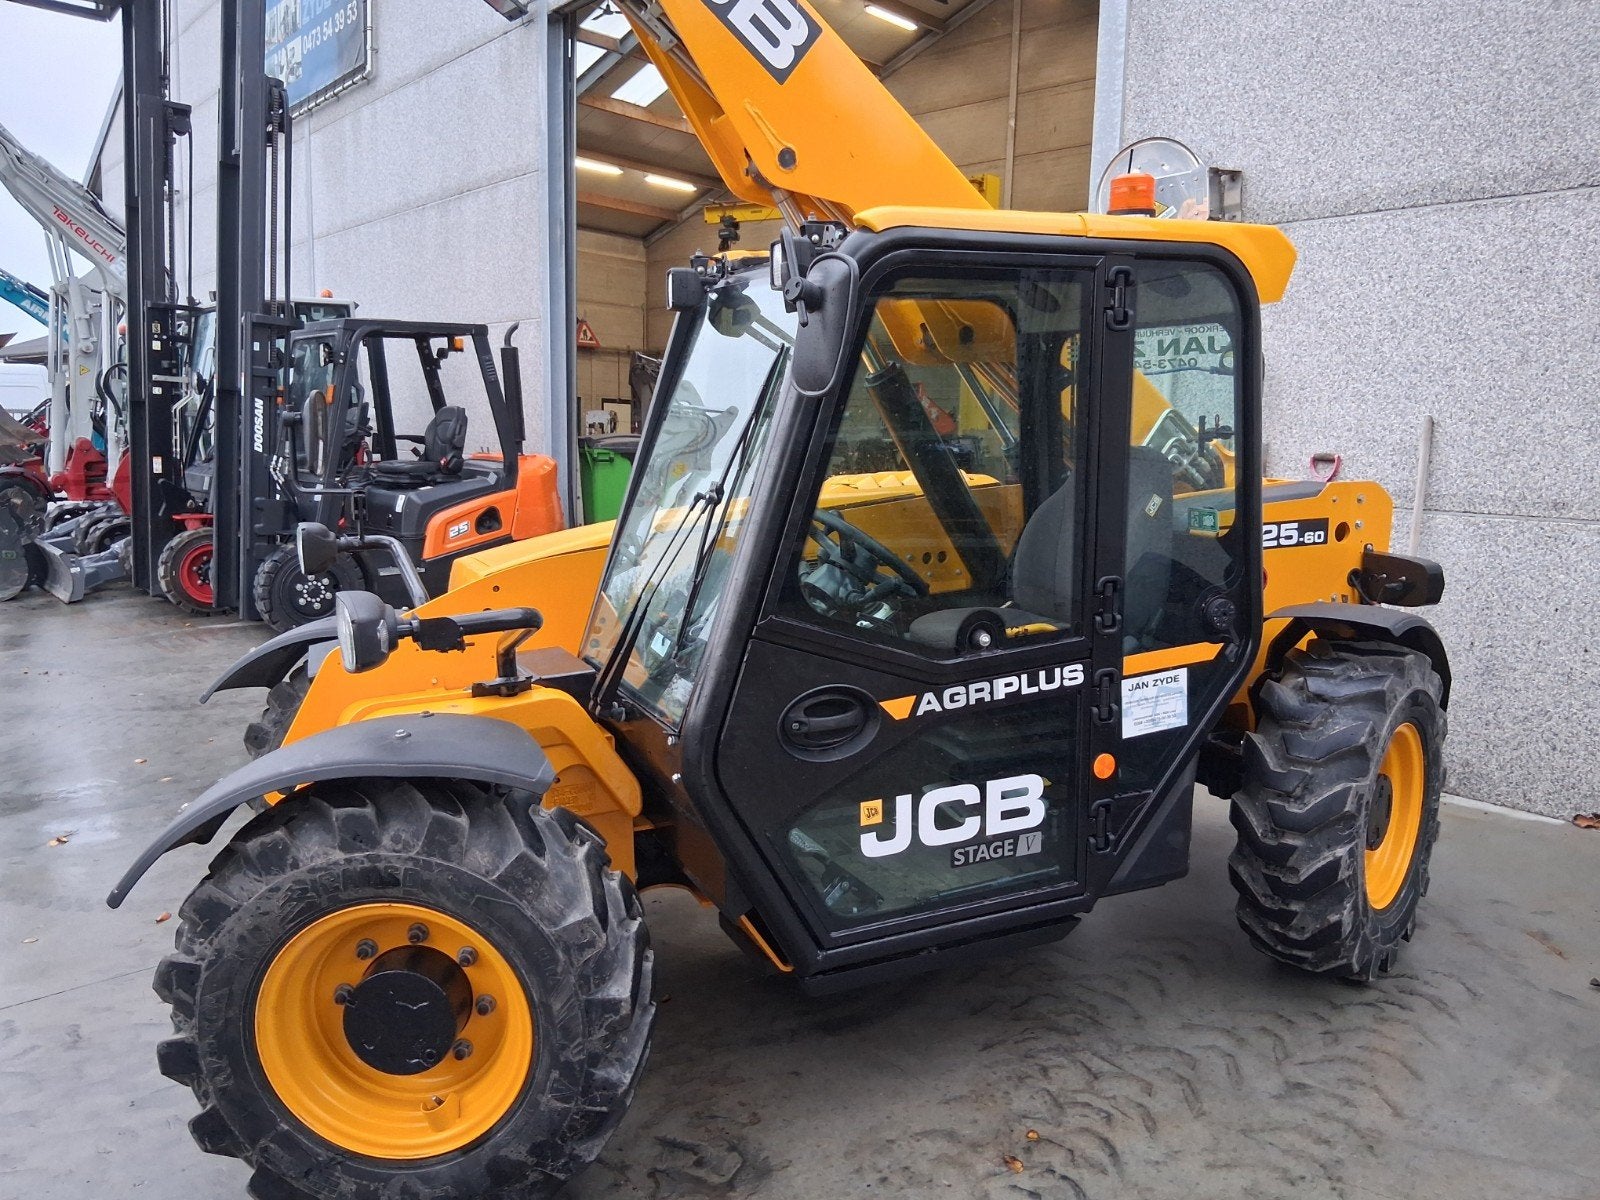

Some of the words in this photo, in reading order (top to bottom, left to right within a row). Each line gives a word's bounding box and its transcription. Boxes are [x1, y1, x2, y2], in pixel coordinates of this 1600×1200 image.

[303, 26, 321, 55] 0473
[323, 17, 333, 41] 54
[334, 9, 345, 33] 39
[347, 0, 358, 24] 53
[711, 0, 809, 69] B
[254, 397, 264, 453] DOOSAN
[449, 520, 470, 539] 25
[916, 663, 1085, 716] AGRIPLUS
[1128, 681, 1149, 692] JAN
[1152, 674, 1180, 687] ZYDE
[860, 773, 1045, 858] JCB
[865, 806, 880, 820] JCB
[953, 838, 1014, 866] STAGE
